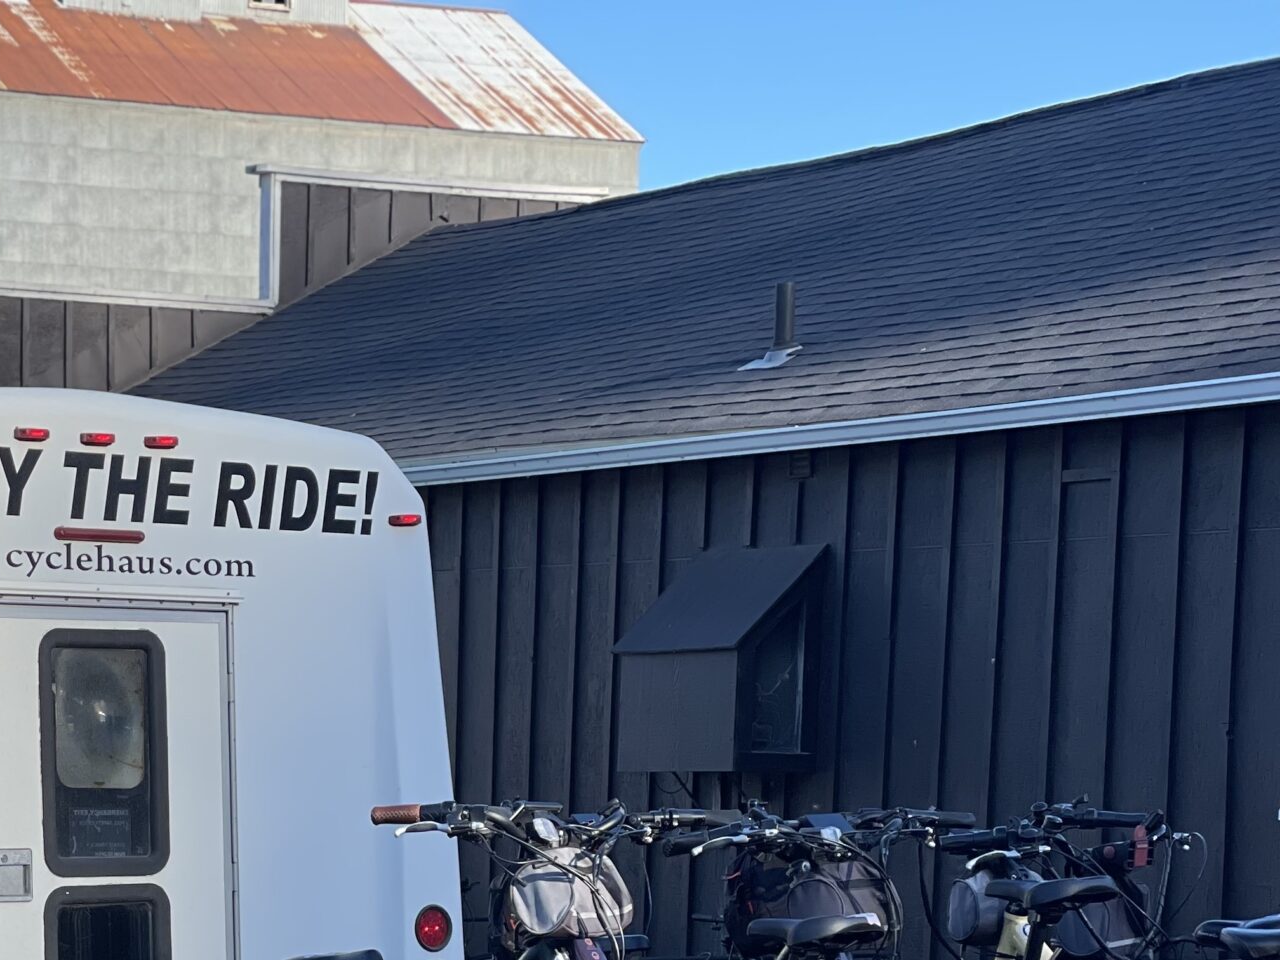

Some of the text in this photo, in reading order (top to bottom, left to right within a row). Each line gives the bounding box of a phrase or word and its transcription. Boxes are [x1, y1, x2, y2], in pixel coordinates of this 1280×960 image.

[63, 451, 195, 526] THE
[213, 461, 379, 535] RIDE!
[6, 543, 256, 578] cyclehaus.com
